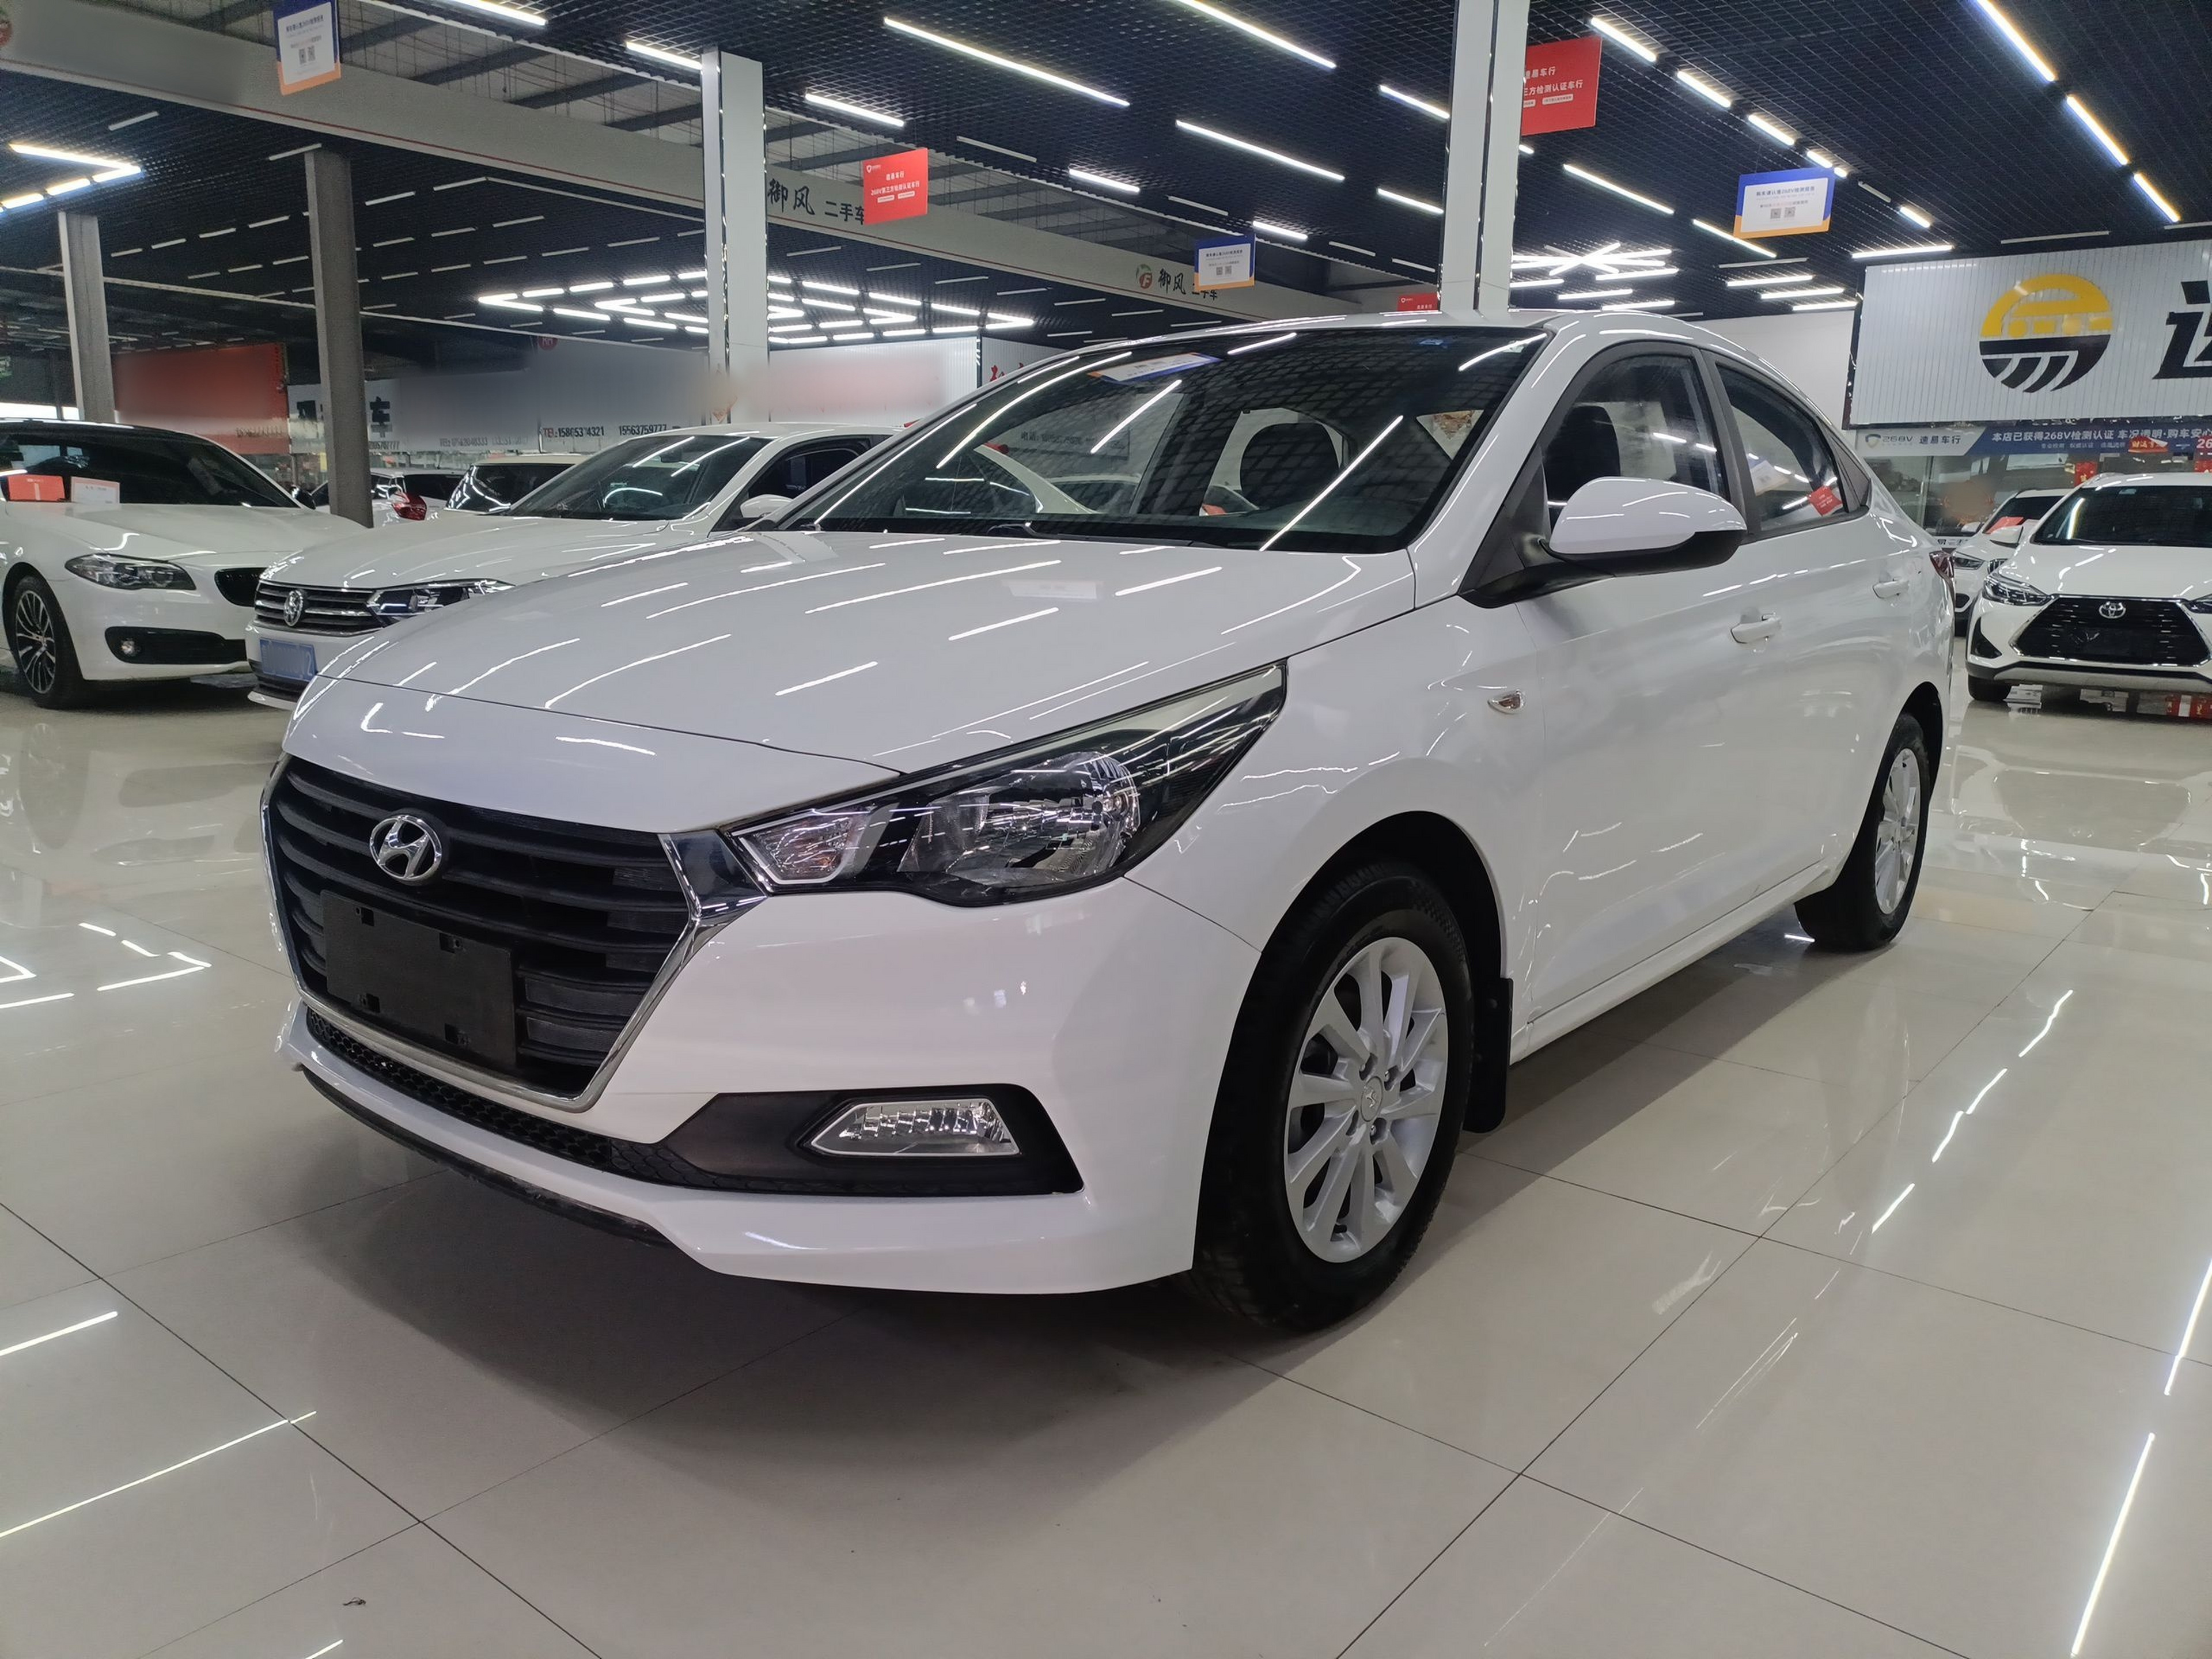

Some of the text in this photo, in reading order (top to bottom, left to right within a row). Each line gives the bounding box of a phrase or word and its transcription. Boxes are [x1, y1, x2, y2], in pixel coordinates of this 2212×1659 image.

[1992, 430, 2114, 442] 本店已获得268V检测认证
